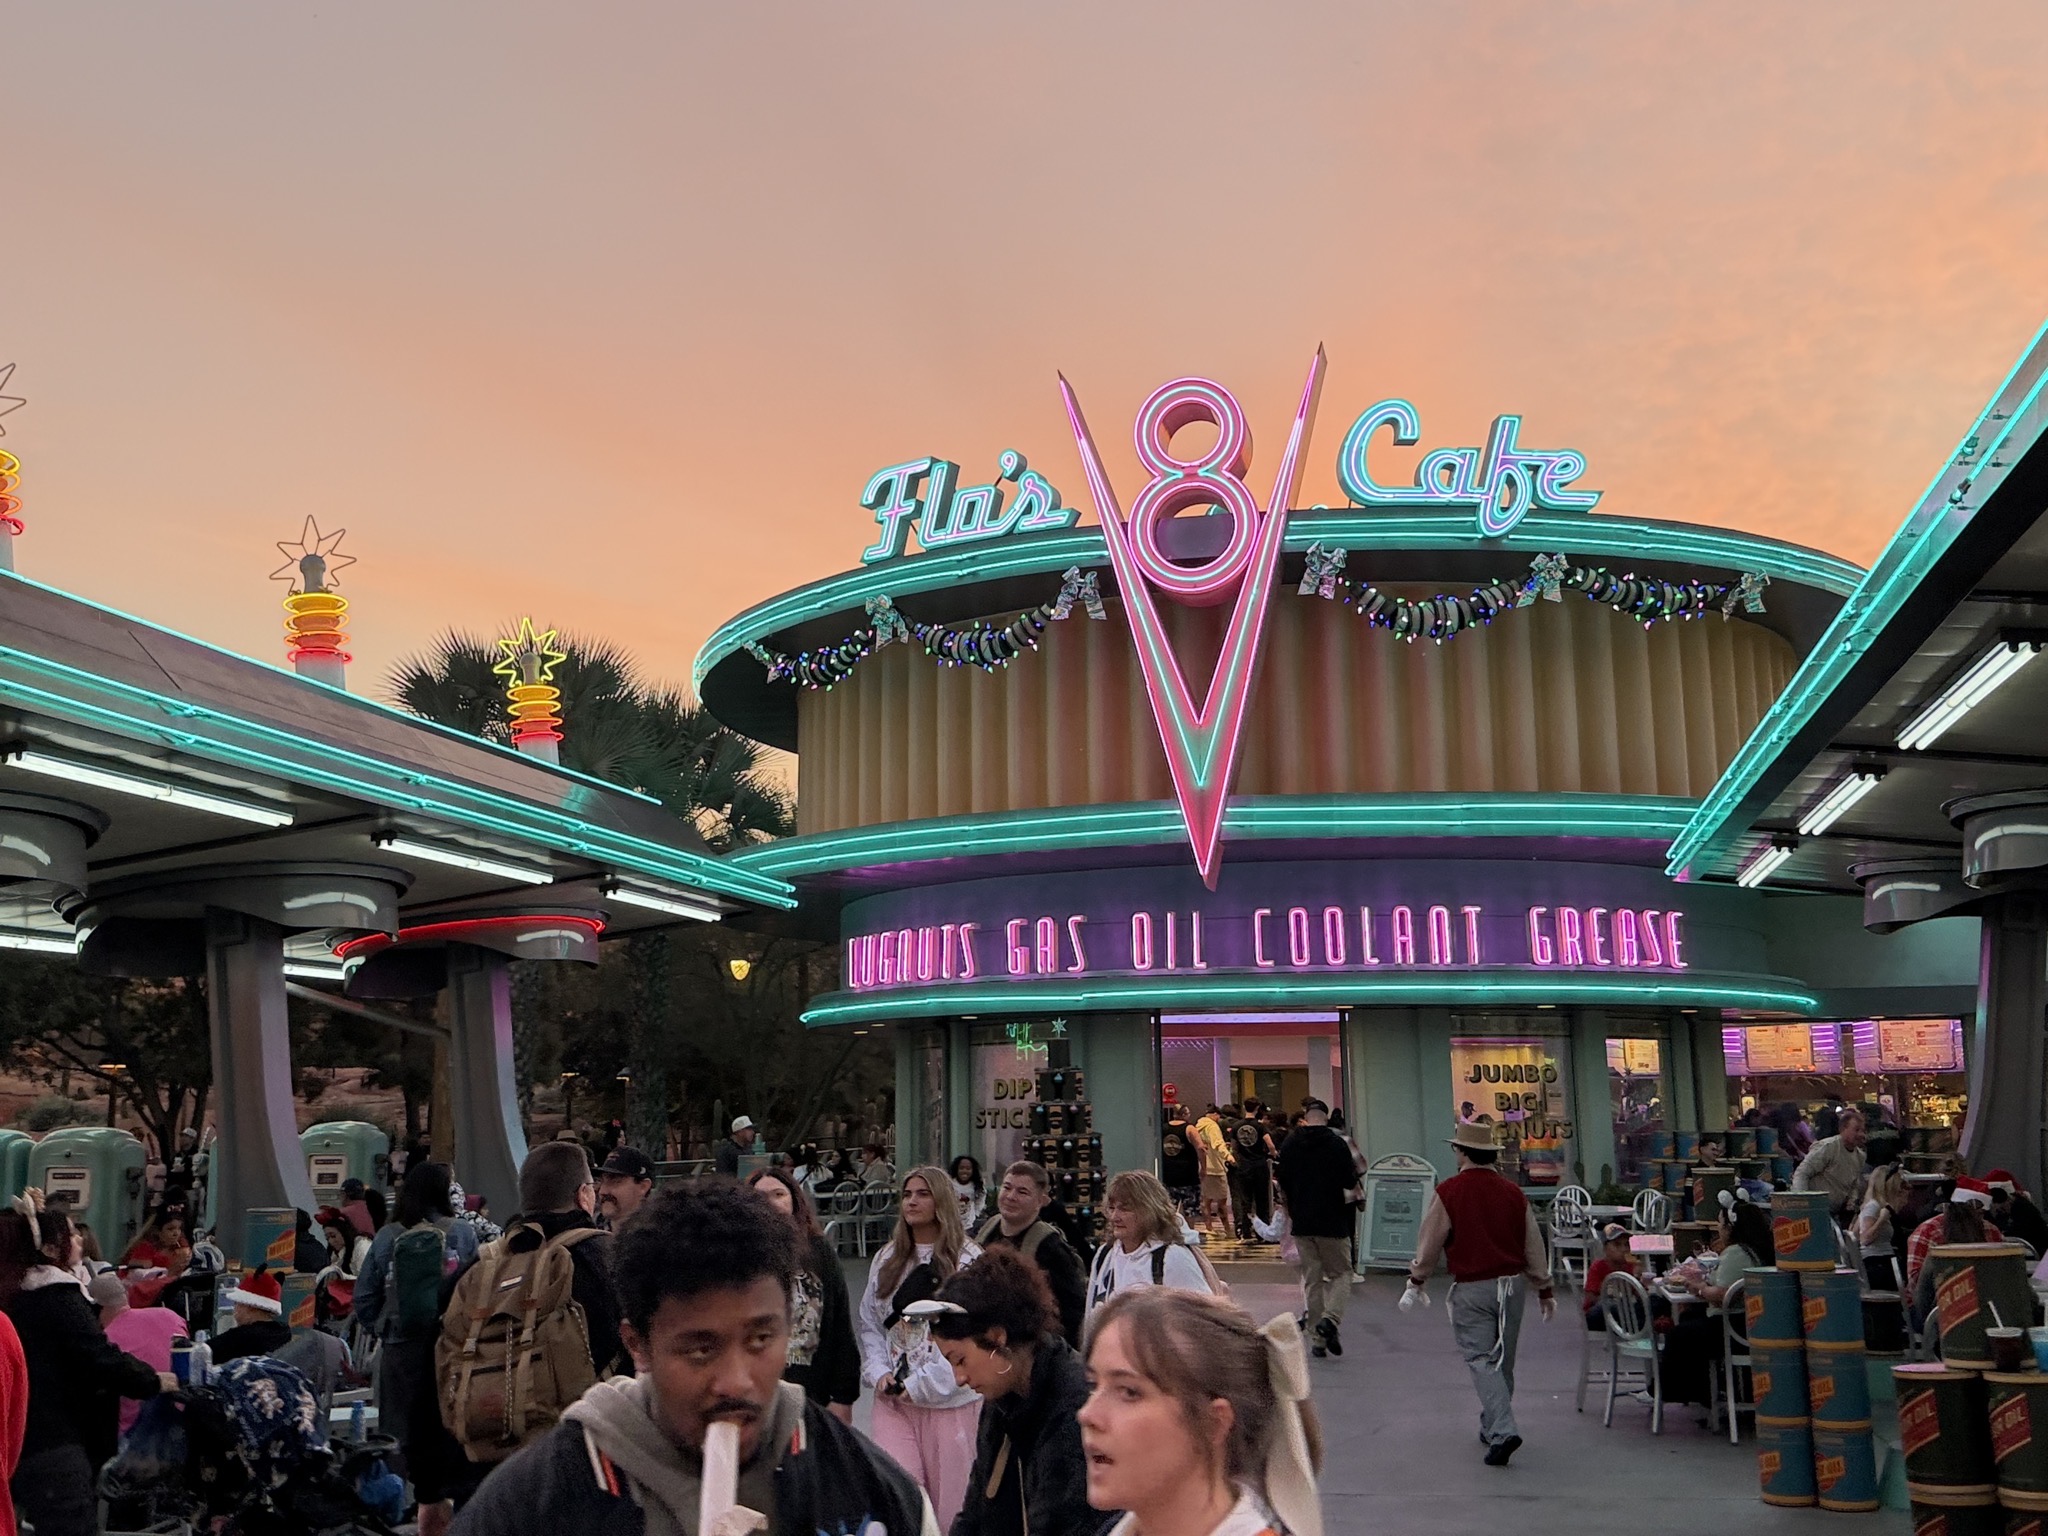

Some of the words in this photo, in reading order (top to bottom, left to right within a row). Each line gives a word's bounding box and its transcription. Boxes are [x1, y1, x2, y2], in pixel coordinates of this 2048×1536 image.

[861, 449, 1081, 565] Flo's
[1338, 398, 1605, 538] Cafe
[848, 922, 980, 989] LUGNUTS
[1006, 915, 1087, 975] GAS
[1132, 911, 1207, 970] OIL
[1253, 906, 1482, 967] COOLANT
[1528, 906, 1688, 968] GREASE
[1469, 1064, 1558, 1083] JUMBO
[994, 1079, 1033, 1100] DIP
[1494, 1092, 1538, 1112] BIG
